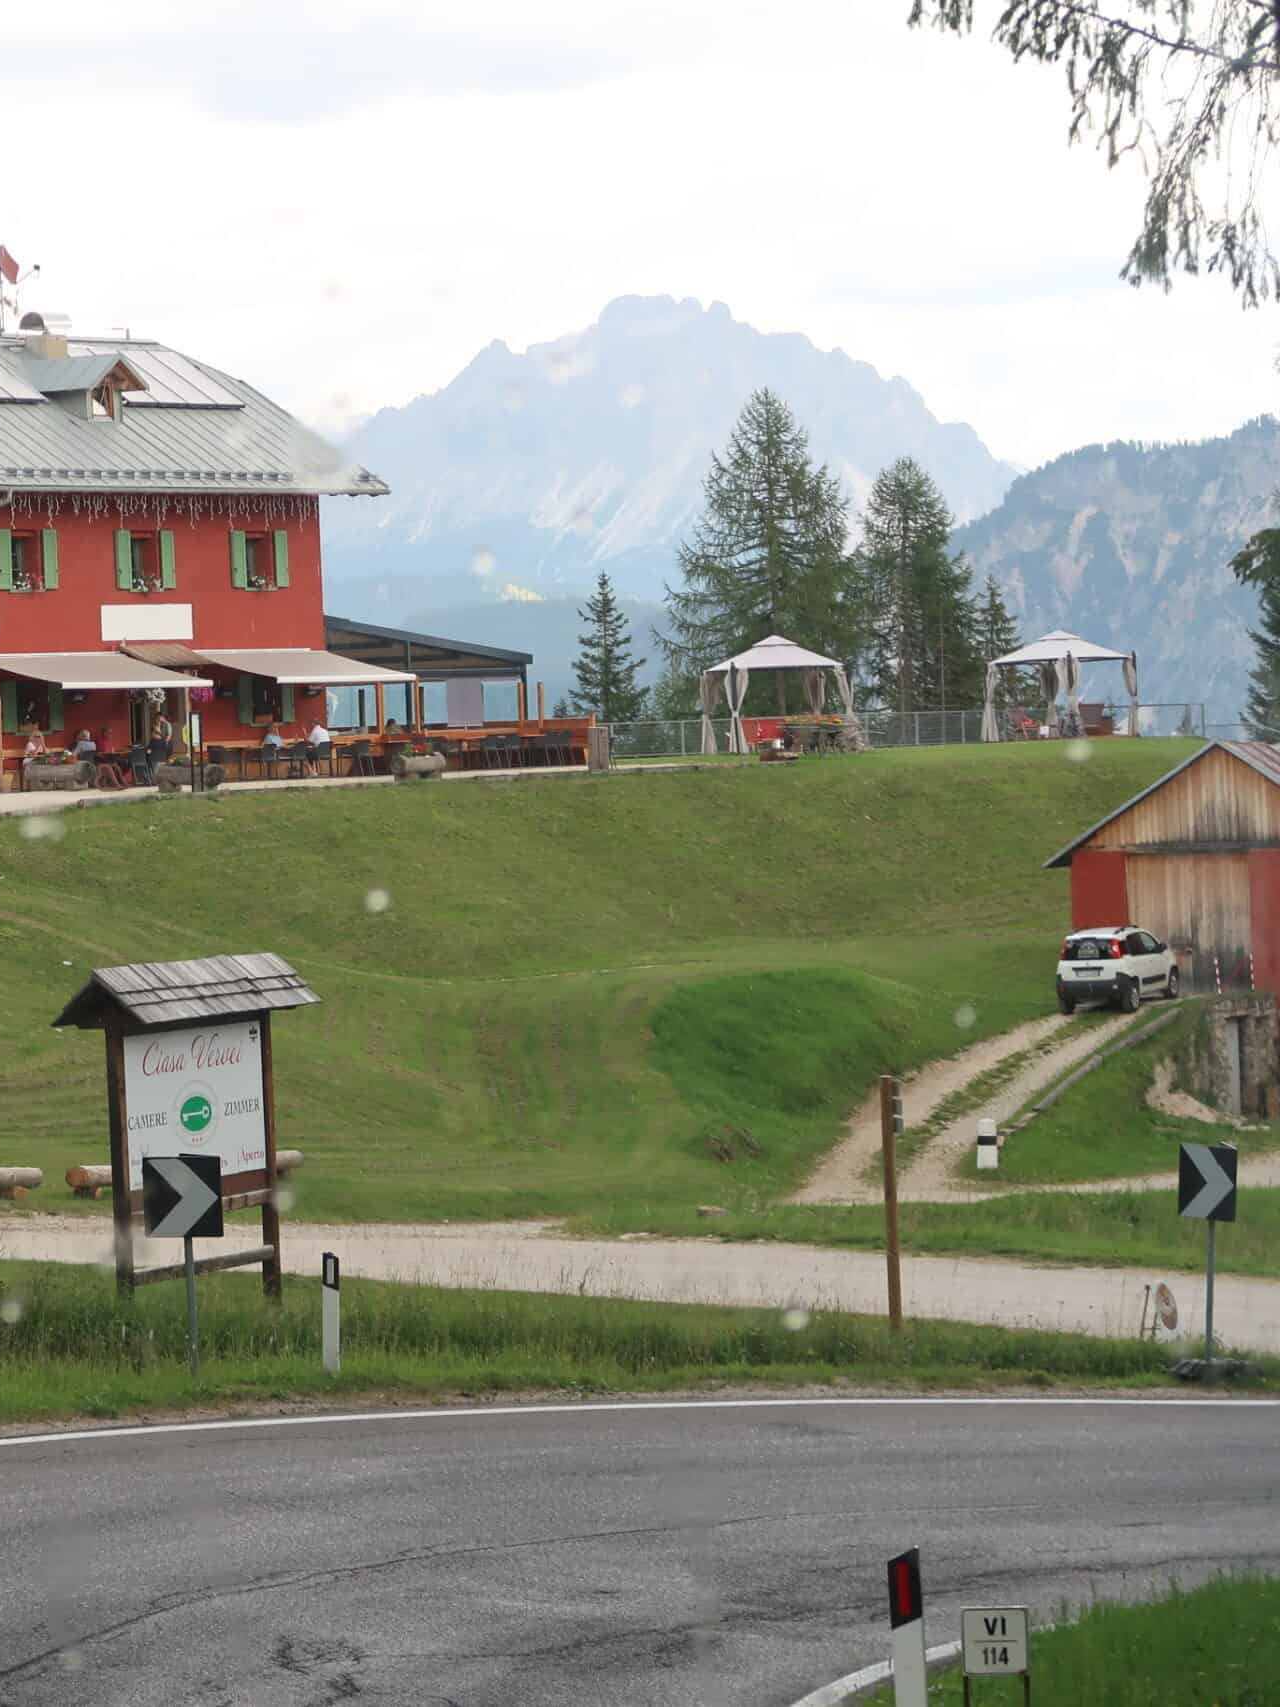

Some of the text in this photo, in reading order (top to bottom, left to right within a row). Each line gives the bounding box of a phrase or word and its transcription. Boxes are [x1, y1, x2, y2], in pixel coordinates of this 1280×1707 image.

[224, 1098, 260, 1116] ZIMMER
[128, 1112, 168, 1131] CAMERE
[984, 1617, 1007, 1636] VI
[981, 1647, 1009, 1665] 114
